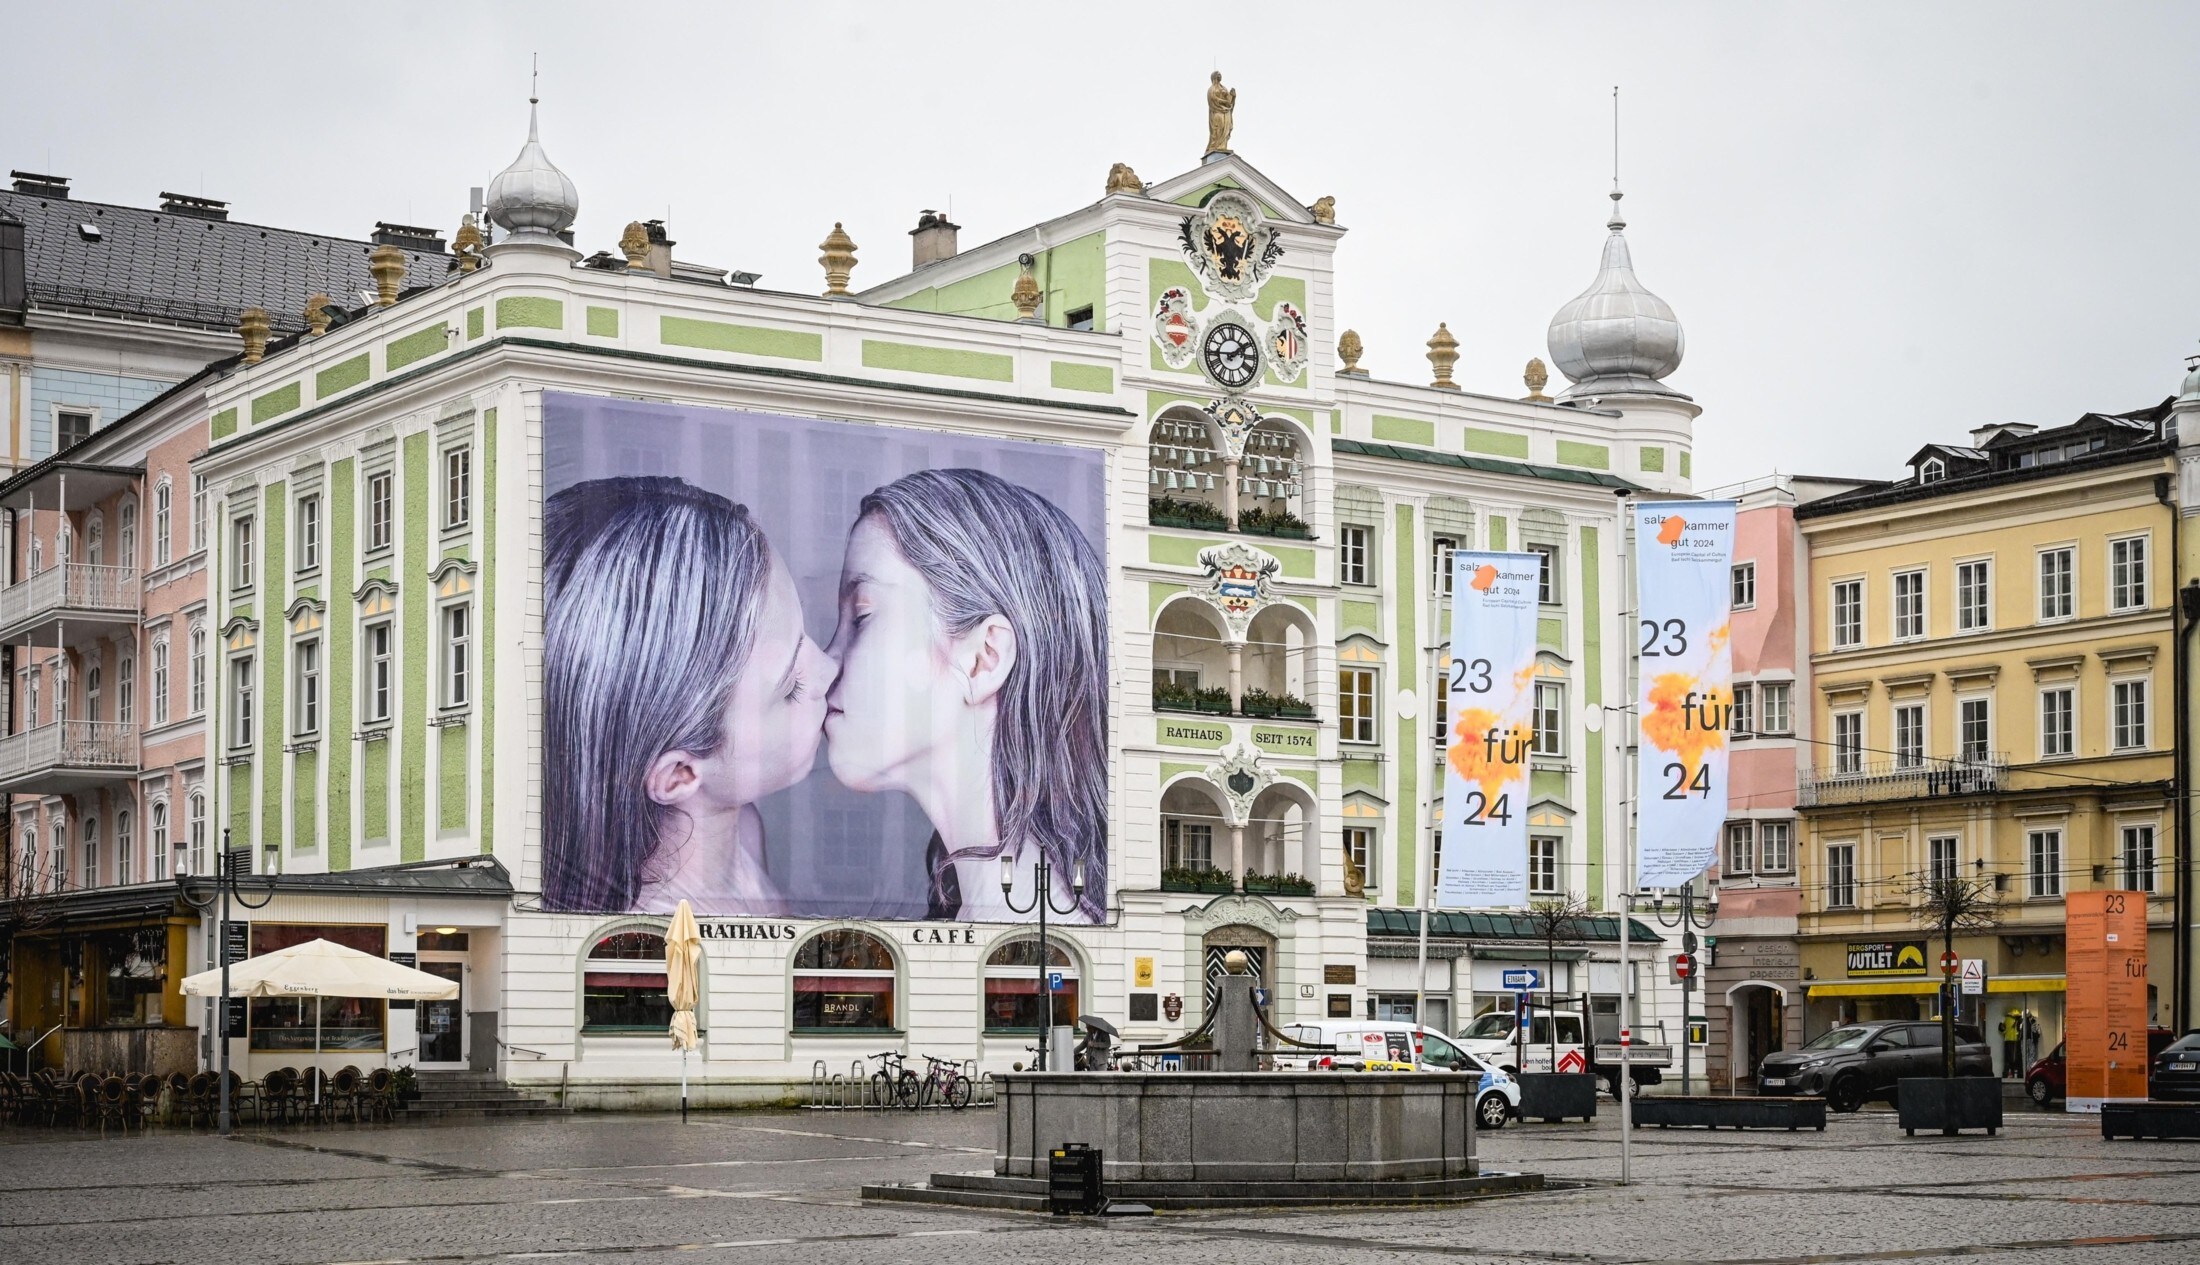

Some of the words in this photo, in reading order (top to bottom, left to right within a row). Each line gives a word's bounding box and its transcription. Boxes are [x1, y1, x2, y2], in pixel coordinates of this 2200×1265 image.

[1644, 514, 1666, 525] salz
[1684, 520, 1730, 531] kammer
[1670, 538, 1689, 550] gut
[1694, 540, 1714, 548] 2024
[1460, 562, 1480, 572] salz
[1495, 570, 1534, 580] kammer
[1482, 584, 1500, 596] gut
[1640, 618, 1687, 656] 23
[1451, 658, 1492, 694] 23
[1681, 692, 1732, 731] für
[1166, 726, 1223, 741] RATHAUS
[1256, 732, 1284, 744] SEIT
[1287, 736, 1312, 746] 1574
[1484, 728, 1532, 764] für
[1663, 762, 1711, 800] 24
[1464, 791, 1512, 826] 24
[2106, 895, 2125, 914] 23
[699, 923, 796, 940] RATHAUS
[912, 924, 975, 944] CAFÉ
[1757, 943, 1788, 955] design
[1848, 944, 1884, 952] BERGSPORT
[1848, 952, 1892, 970] OUTLET
[2125, 958, 2148, 978] für
[1052, 974, 1060, 988] P
[1508, 975, 1526, 983] EINBAHN
[1750, 968, 1796, 980] papeterie
[284, 984, 318, 993] Eggenberg
[824, 1004, 860, 1012] BRANDL
[2108, 1032, 2128, 1051] 24
